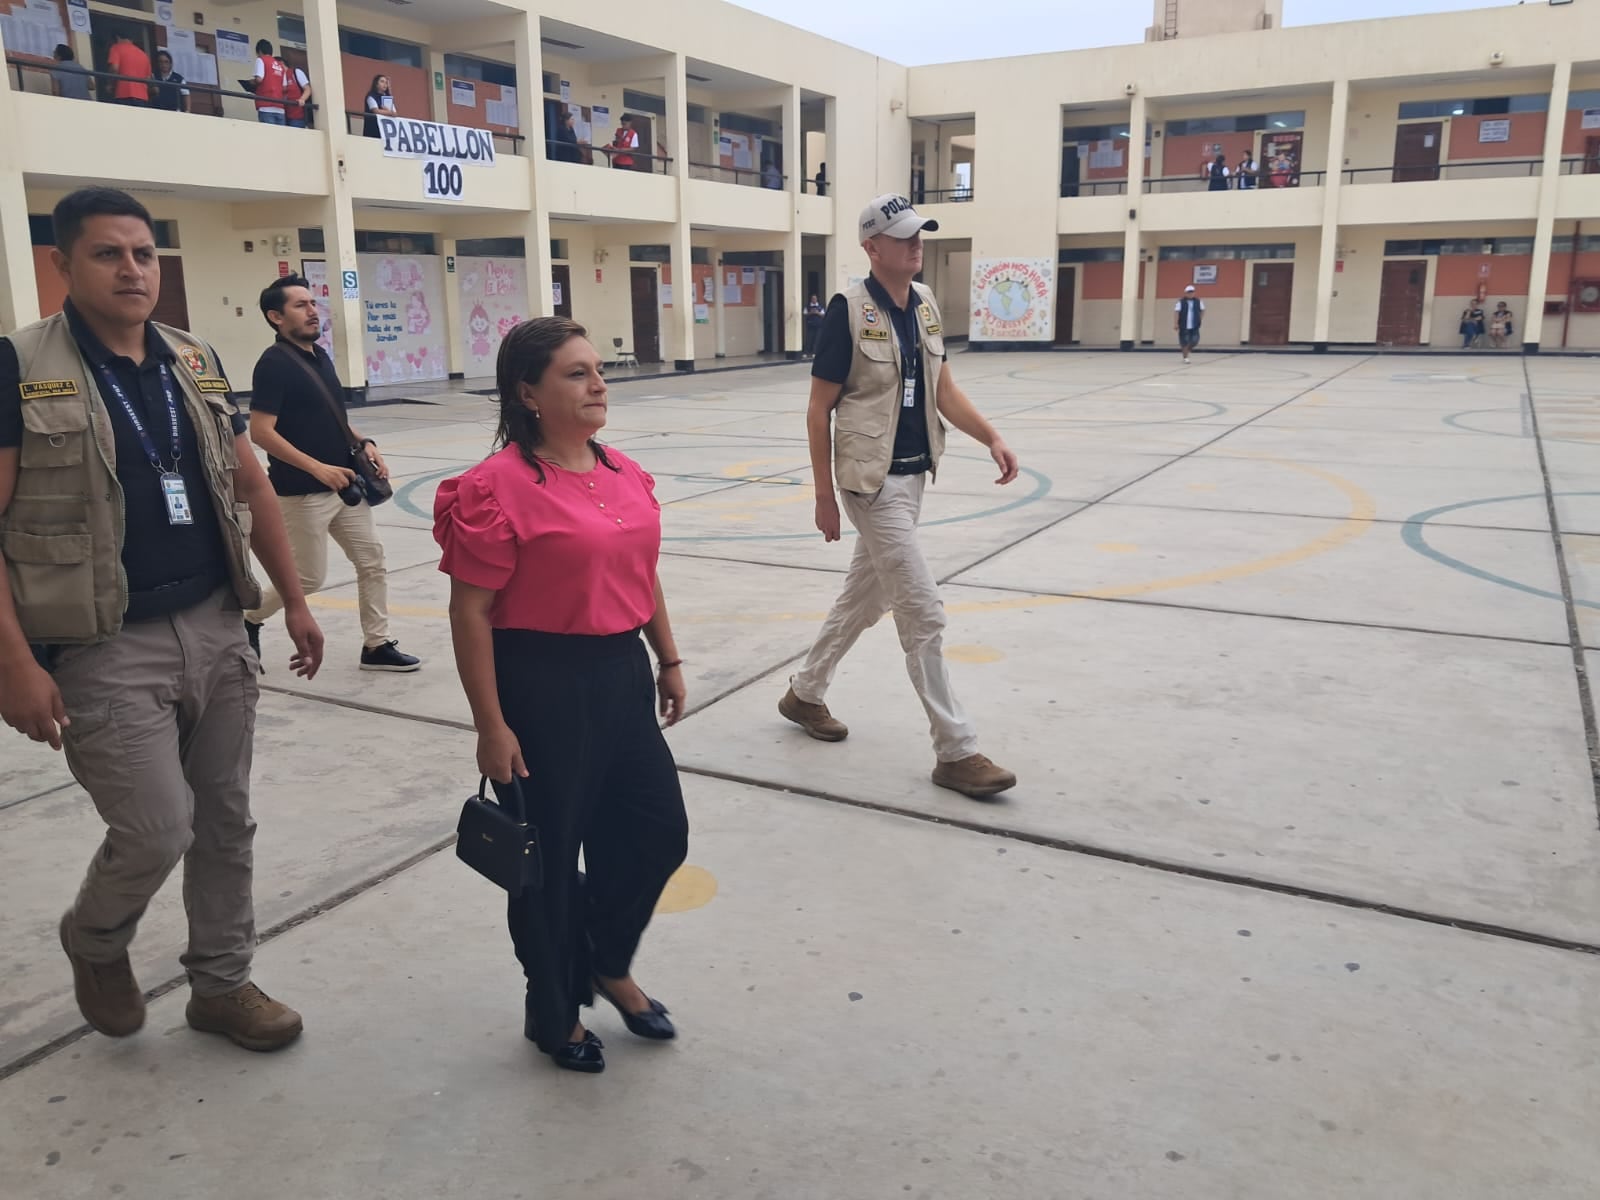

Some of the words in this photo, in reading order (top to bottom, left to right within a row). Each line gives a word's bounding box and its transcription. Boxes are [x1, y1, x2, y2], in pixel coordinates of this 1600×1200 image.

[380, 118, 494, 162] PABELLON
[424, 162, 463, 196] 100
[344, 272, 356, 288] S
[33, 382, 65, 391] VASQUEZ
